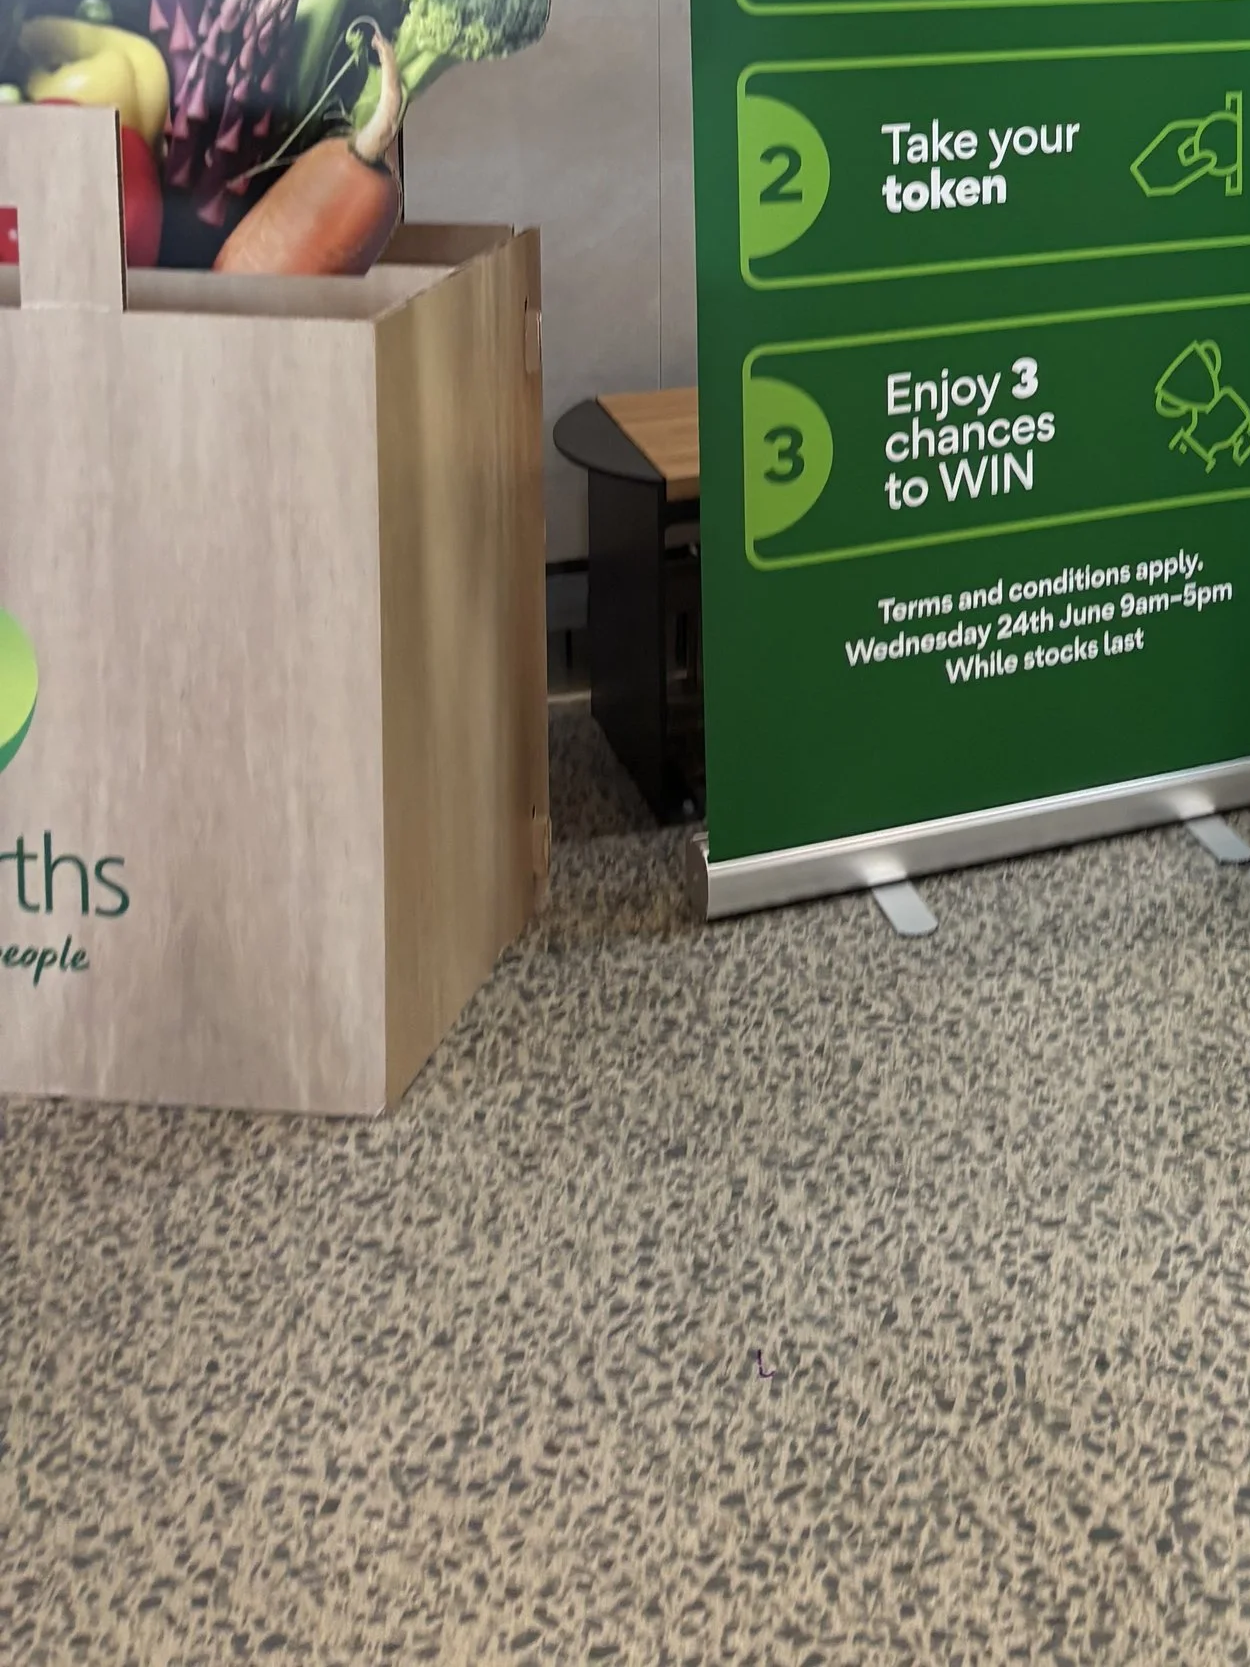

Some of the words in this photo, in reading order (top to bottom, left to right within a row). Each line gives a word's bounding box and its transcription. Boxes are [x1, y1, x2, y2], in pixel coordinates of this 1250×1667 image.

[881, 119, 978, 165] Take
[988, 122, 1080, 168] your
[759, 144, 803, 205] 2
[881, 165, 1007, 213] token
[887, 369, 1001, 420] Enjoy
[1011, 357, 1039, 399] 3
[763, 425, 805, 484] 3
[885, 411, 1056, 462] chances
[884, 472, 929, 510] to
[937, 449, 1034, 502] WIN
[877, 594, 953, 624] Terms
[958, 578, 1003, 611] and
[1008, 564, 1131, 602] conditions
[1135, 548, 1204, 584] apply.
[845, 620, 992, 667] Wednesday
[996, 606, 1054, 640] 24th
[1059, 602, 1115, 629] June
[945, 649, 1019, 684] While
[1023, 635, 1099, 670] stocks
[1103, 627, 1144, 656] last
[0, 934, 90, 989] eople
